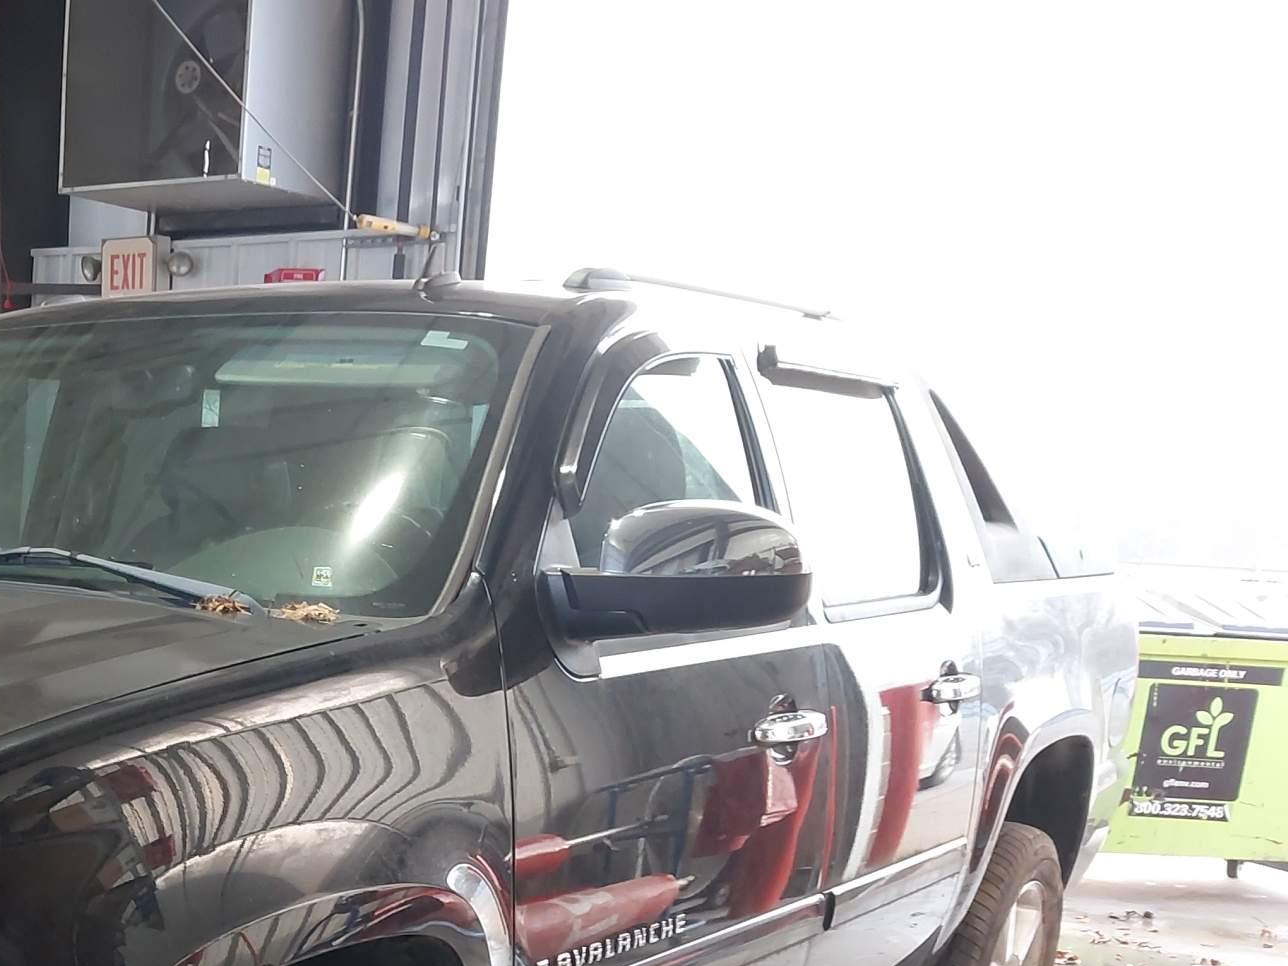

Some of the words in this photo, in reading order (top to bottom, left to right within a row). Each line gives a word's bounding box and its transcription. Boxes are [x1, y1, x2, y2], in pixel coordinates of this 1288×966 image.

[110, 252, 147, 290] EXIT
[1171, 666, 1218, 678] GARBAGE
[1218, 669, 1247, 679] ONLY
[1160, 724, 1225, 758] GFL
